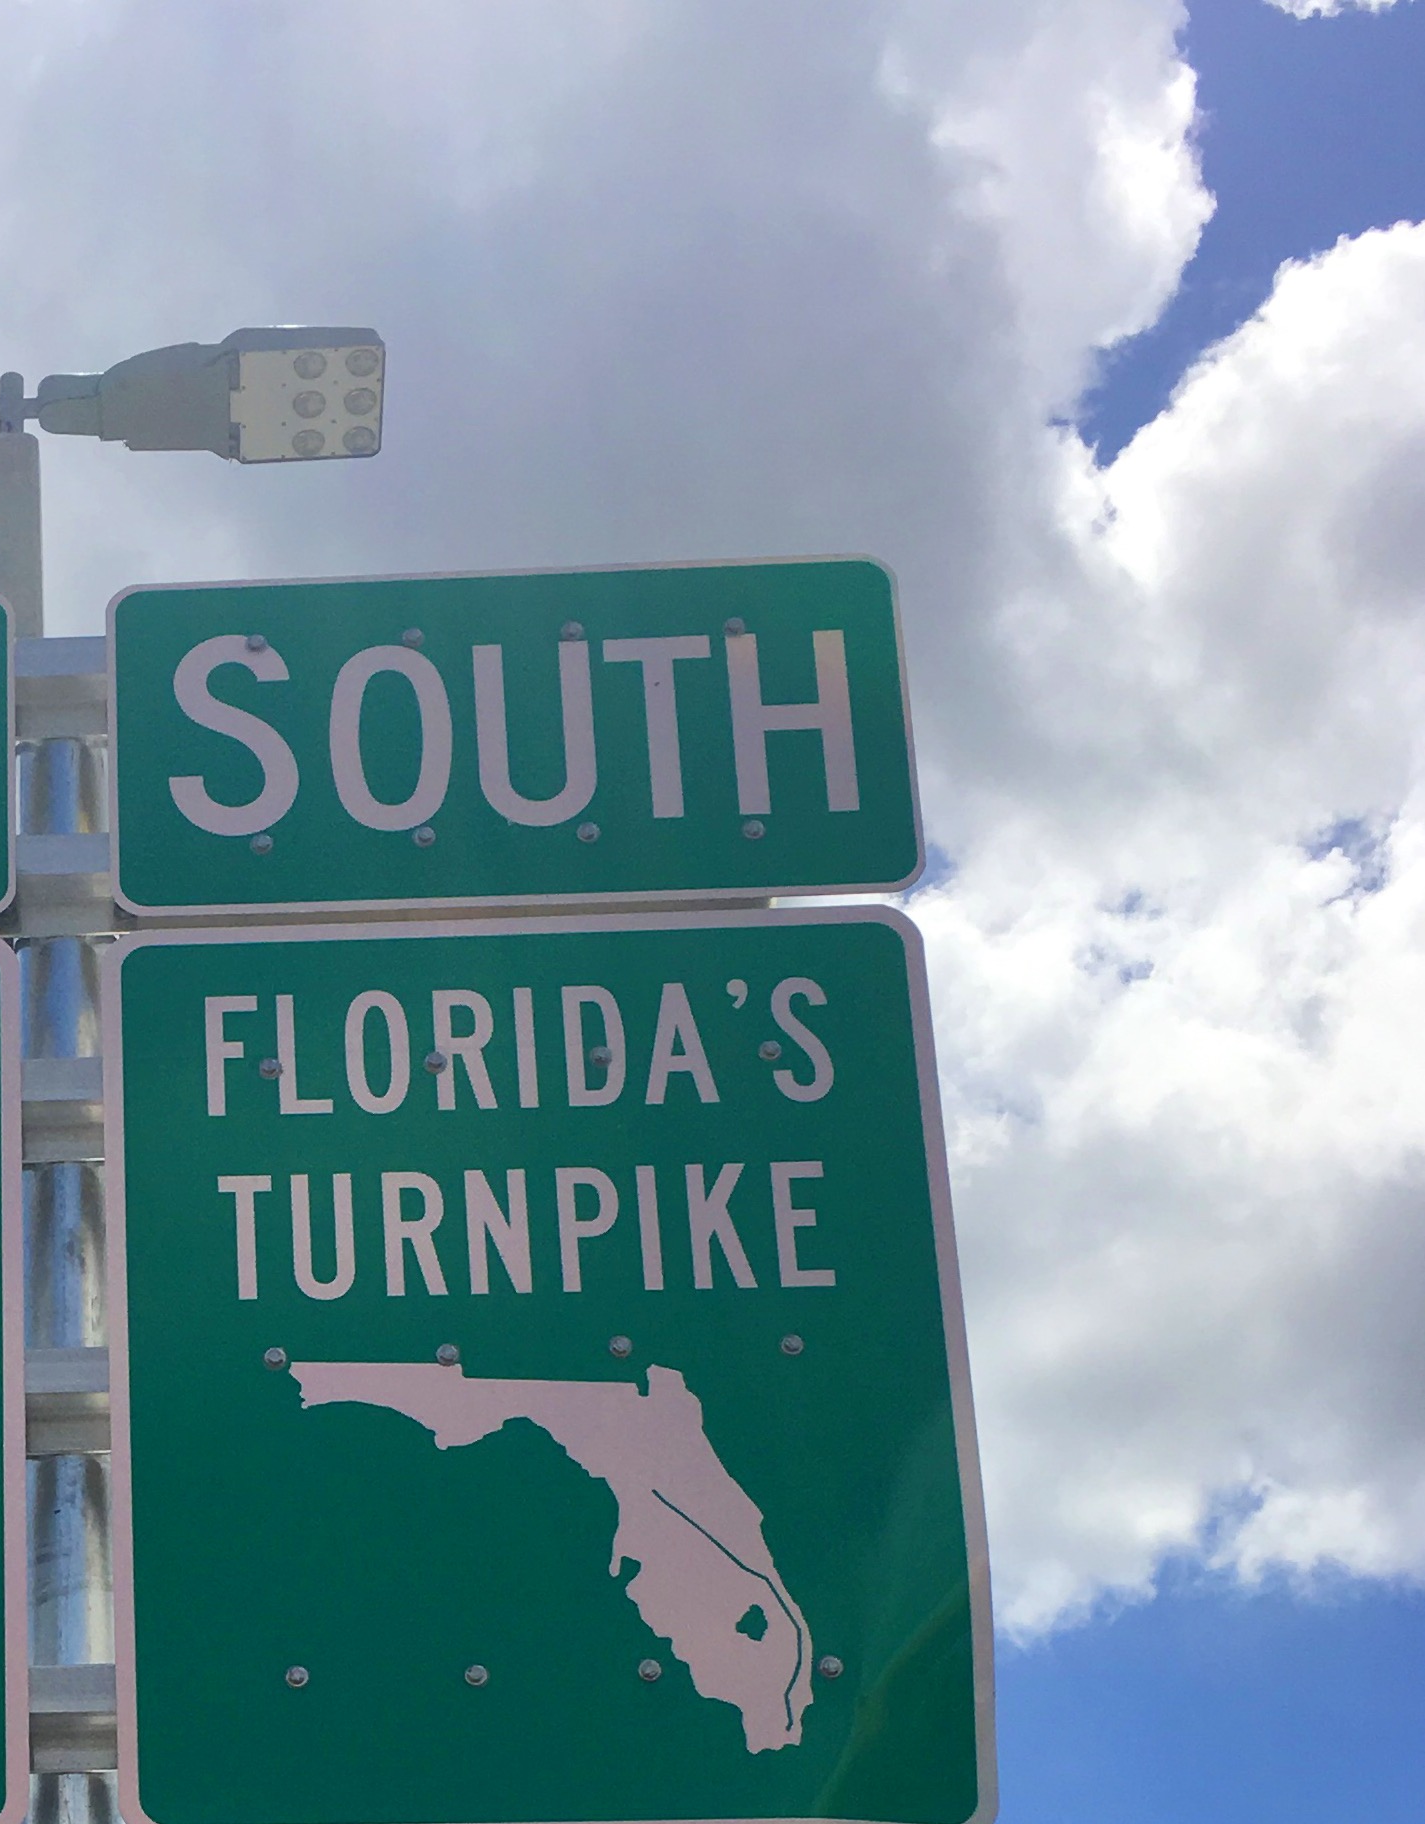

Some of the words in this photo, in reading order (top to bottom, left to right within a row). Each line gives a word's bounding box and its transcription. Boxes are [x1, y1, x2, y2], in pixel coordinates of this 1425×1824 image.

[168, 628, 861, 837] SOUTH
[203, 977, 835, 1117] FLORIDA'S
[217, 1160, 836, 1301] TURNPIKE
